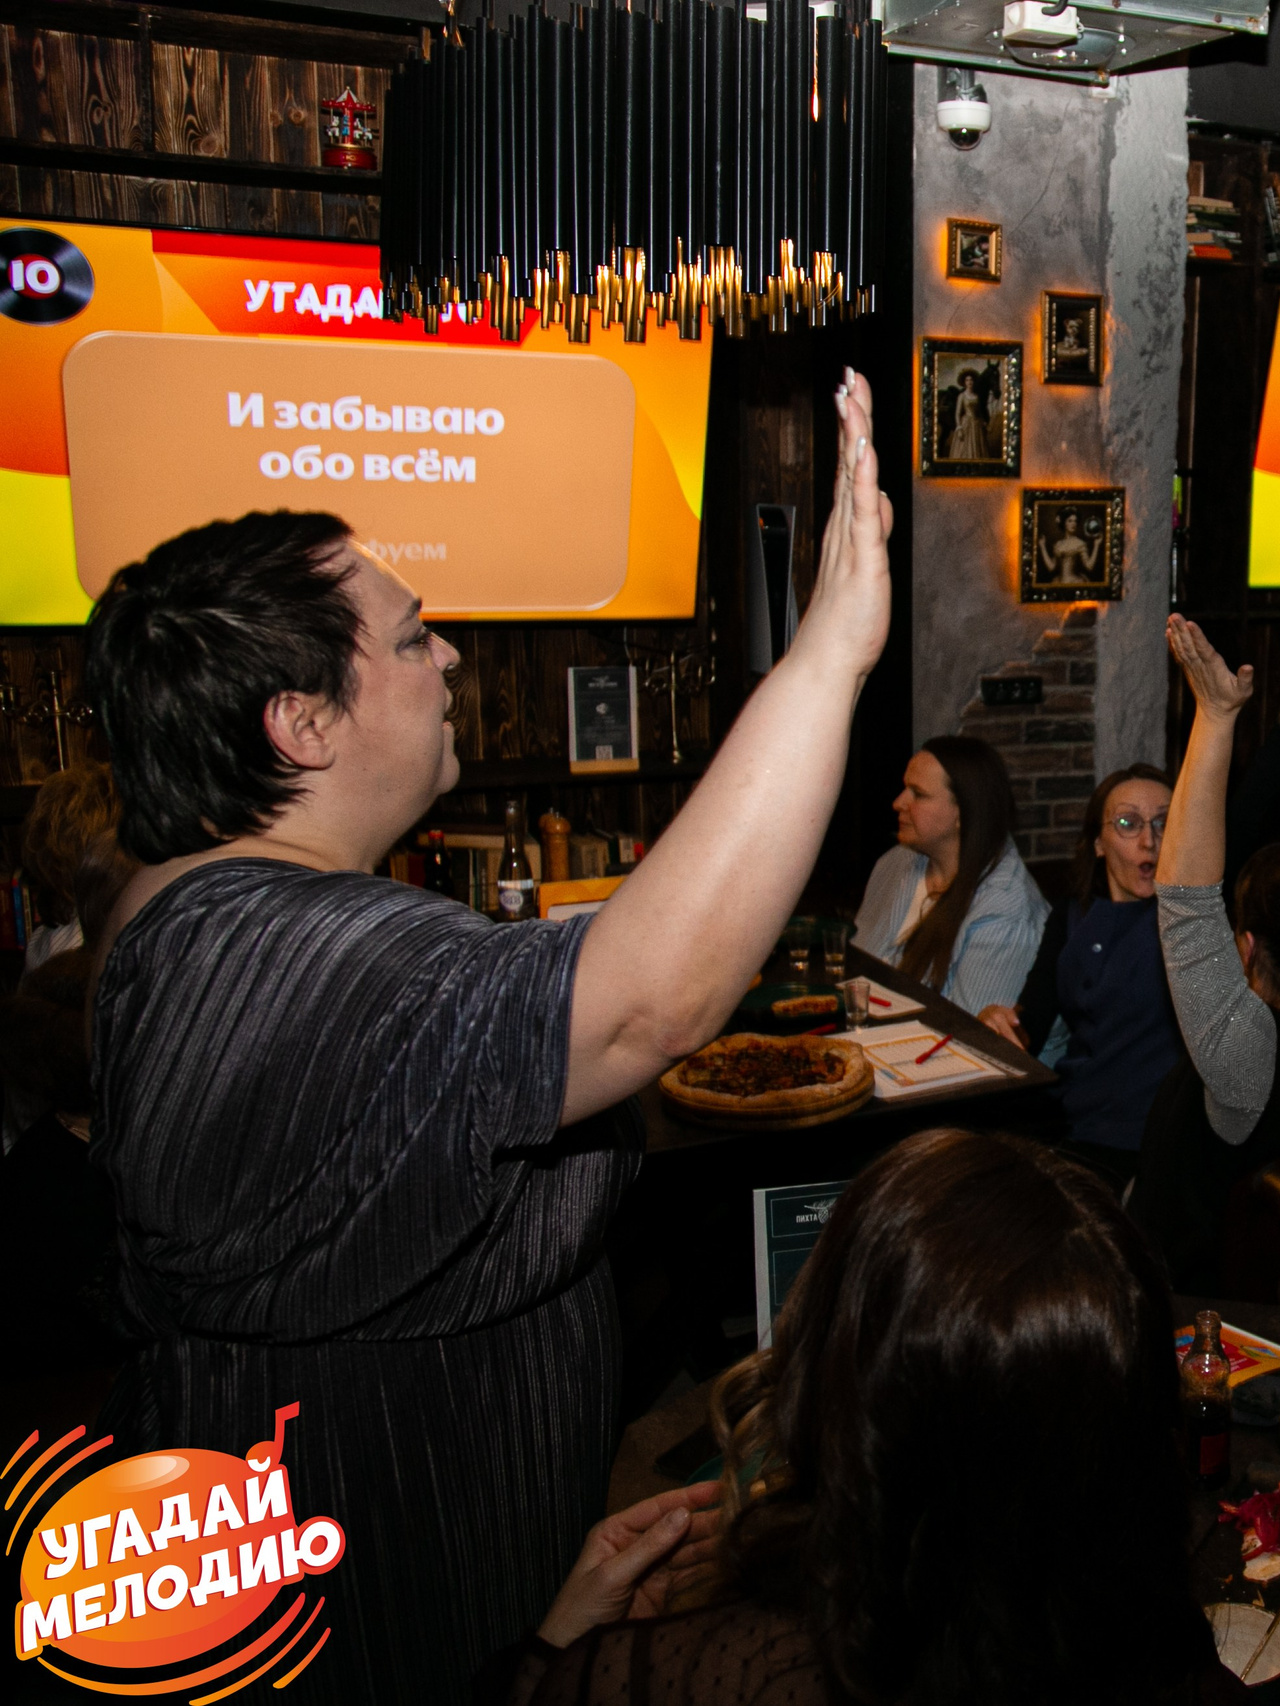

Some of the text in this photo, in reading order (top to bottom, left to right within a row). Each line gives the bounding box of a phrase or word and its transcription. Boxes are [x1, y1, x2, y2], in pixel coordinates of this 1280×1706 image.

[244, 279, 383, 325] УГАДА
[227, 391, 506, 437] И забываю
[258, 443, 477, 483] обо всём
[796, 1214, 818, 1223] ПИХТА
